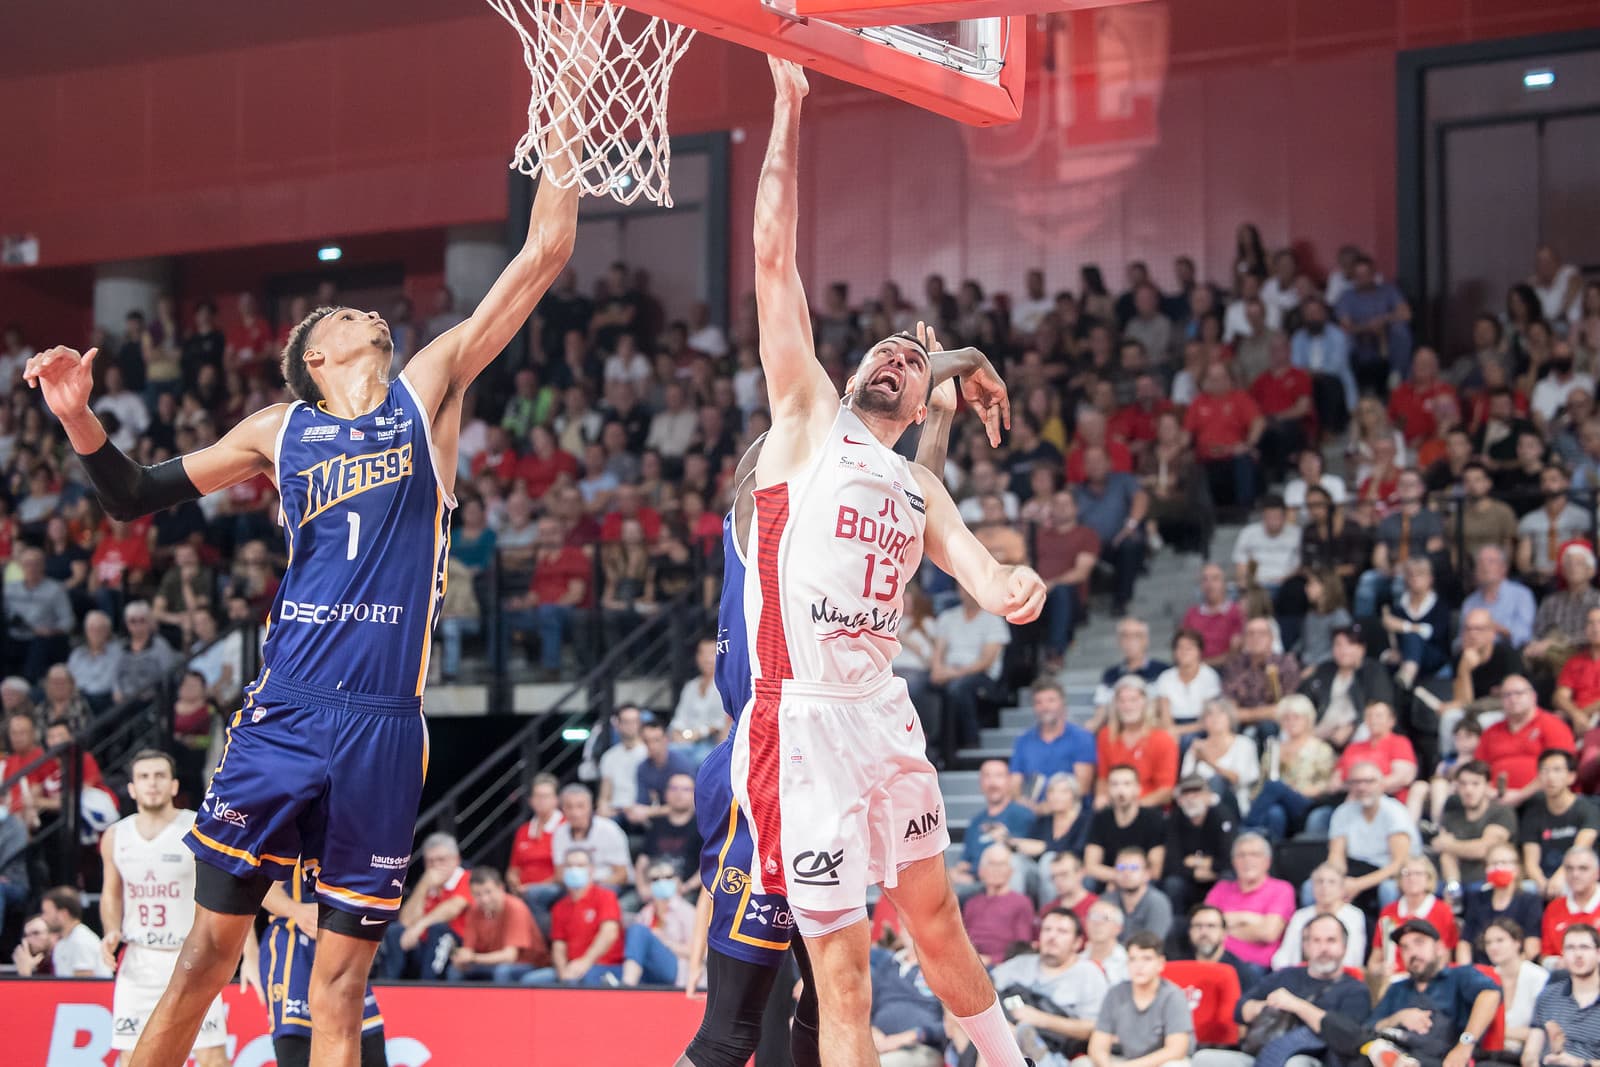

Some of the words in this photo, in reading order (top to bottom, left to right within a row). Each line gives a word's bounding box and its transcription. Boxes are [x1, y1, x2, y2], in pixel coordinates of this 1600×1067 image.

[346, 511, 361, 561] 1
[862, 553, 899, 601] 13
[213, 796, 249, 825] idex
[138, 904, 167, 928] 83
[773, 906, 796, 925] ide
